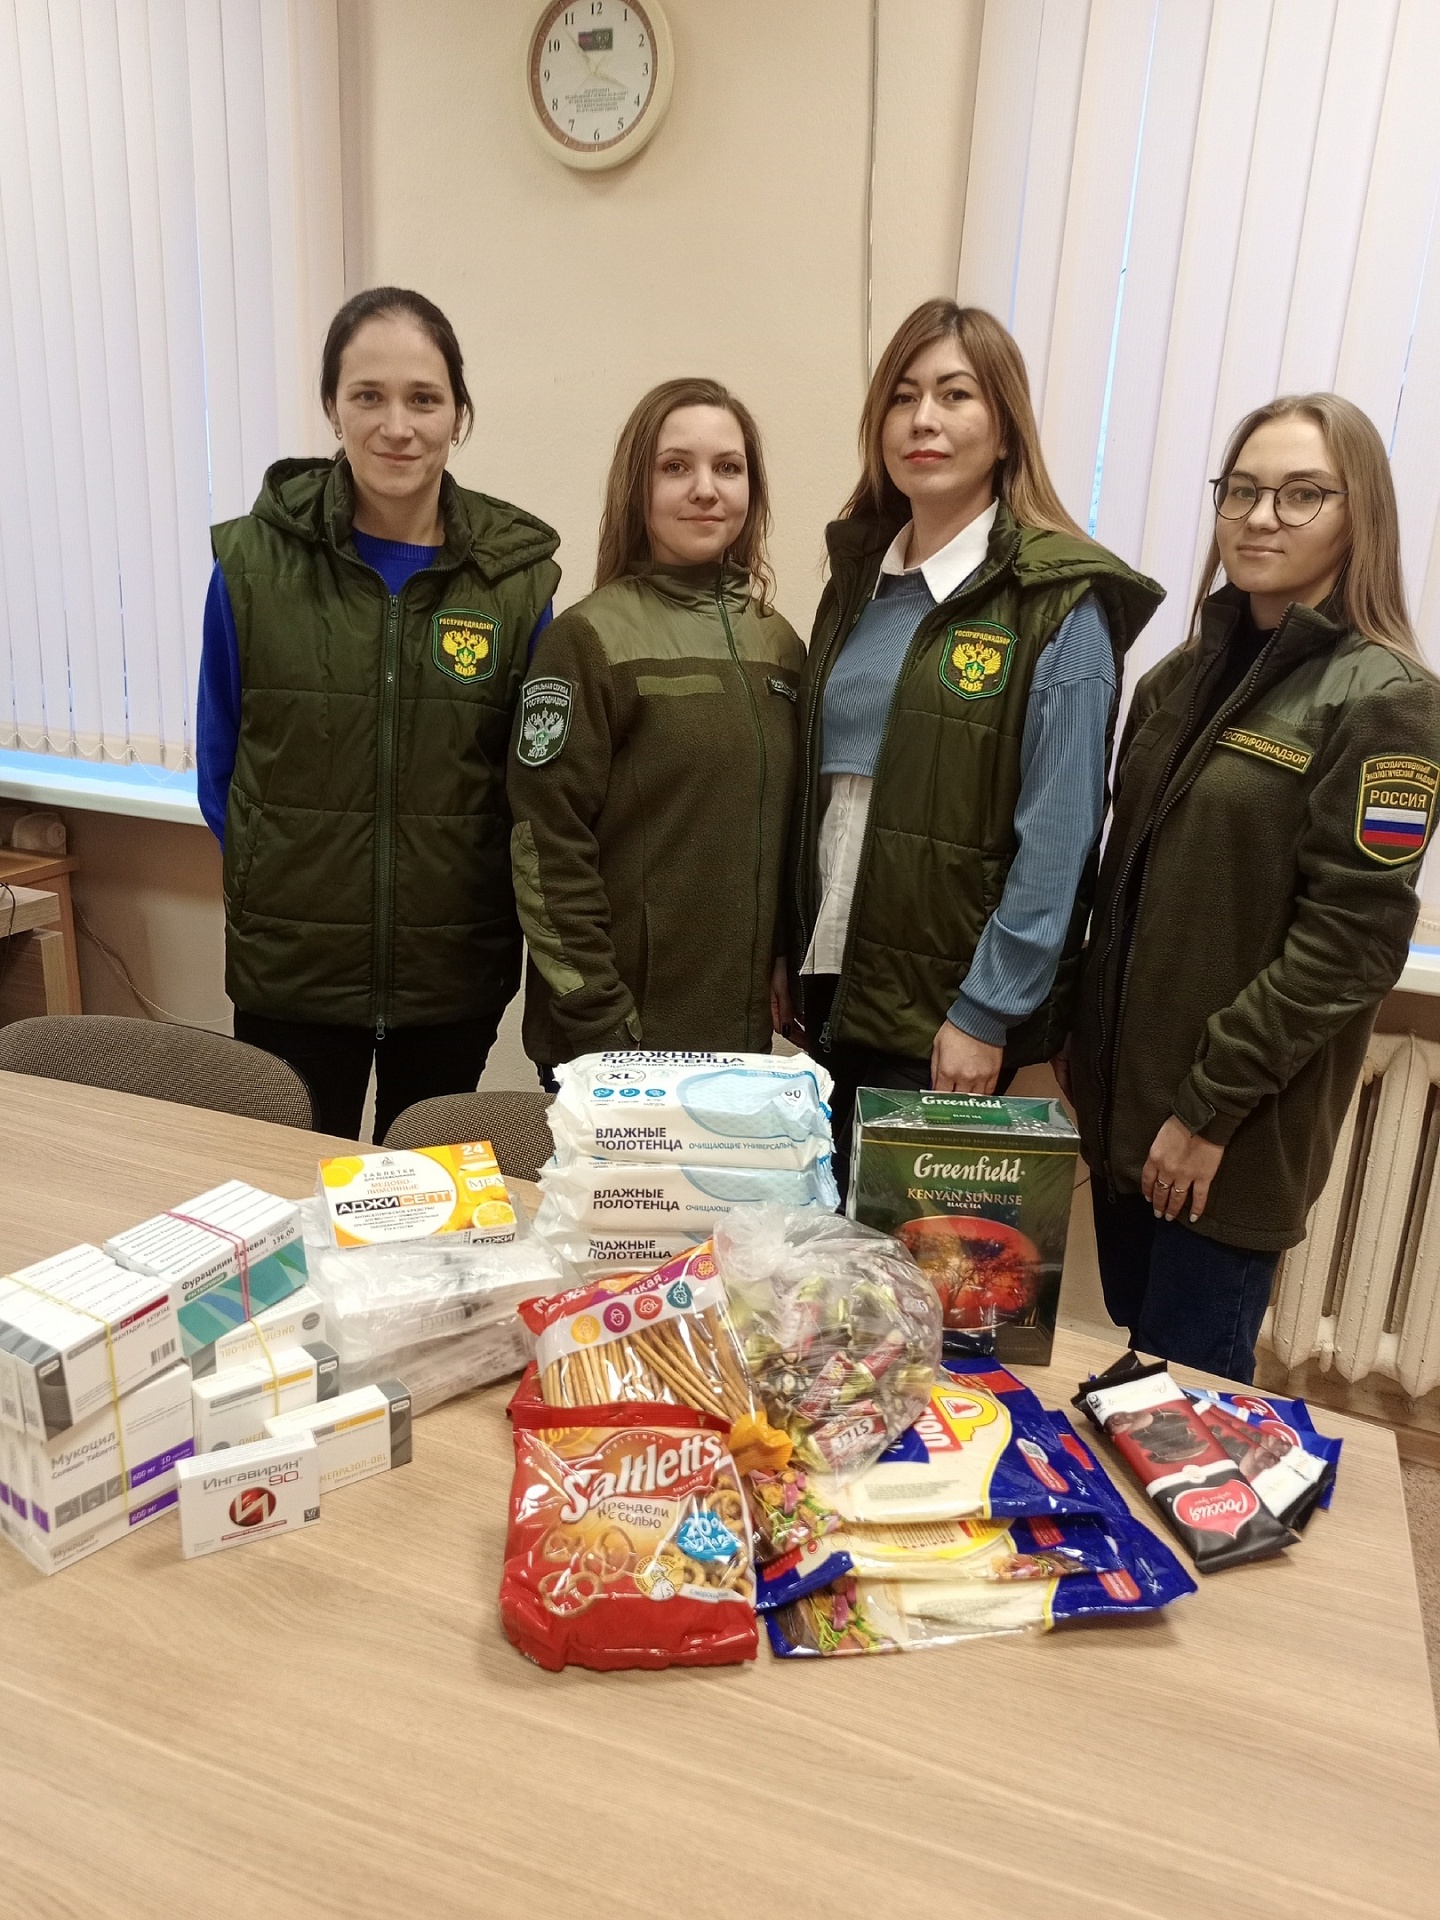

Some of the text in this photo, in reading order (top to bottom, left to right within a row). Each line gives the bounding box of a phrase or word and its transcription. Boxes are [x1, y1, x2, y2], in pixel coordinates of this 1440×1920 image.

[590, 2, 603, 15] 12
[623, 9, 628, 21] 1
[564, 13, 574, 25] 11
[548, 39, 560, 52] 10
[638, 34, 645, 48] 2
[543, 70, 550, 82] 9
[642, 63, 649, 76] 3
[551, 98, 559, 111] 8
[633, 93, 641, 107] 4
[568, 119, 575, 132] 7
[617, 117, 624, 130] 5
[593, 129, 600, 141] 6
[1222, 731, 1307, 766] РОСПРИРОДНАДЗОР
[1369, 789, 1428, 809] РОССИЯ
[601, 1057, 745, 1065] ПОЛОТЕНЦА
[602, 1051, 717, 1060] ВЛАЖНЫЕ
[608, 1072, 636, 1081] XL
[921, 1095, 1003, 1109] Greenfield
[596, 1127, 667, 1139] ВЛАЖНЫЕ
[461, 1144, 484, 1156] 24
[596, 1139, 797, 1152] ПОЛОТЕНЦА ОЧИЩАЮЩИЕ УНИВЕРСАЛЬН
[913, 1152, 1021, 1183] Greenfield
[593, 1188, 664, 1199] ВЛАЖНЫЕ
[907, 1187, 1022, 1206] KENYAN SUNRISE
[337, 1191, 450, 1215] АДЖИСЕПТ
[593, 1199, 680, 1212] ПОЛОТЕНЦА
[947, 1201, 969, 1209] BLACK
[588, 1238, 656, 1251] ВЛАЖНЫЕ
[587, 1247, 673, 1260] ПОЛОТЕНЦА
[181, 1256, 233, 1290] Фурацилин
[51, 1431, 117, 1469] Мукоцил
[605, 1433, 664, 1455] ORIGINAL
[160, 1455, 172, 1466] 10
[318, 1453, 389, 1482] МЕПРАЗОЛ-OBL
[132, 1470, 148, 1482] 600
[203, 1460, 299, 1491] Ингавирин
[268, 1471, 299, 1486] 90
[559, 1433, 722, 1523] Saltletts
[1187, 1491, 1249, 1522] Россия
[131, 1508, 147, 1521] 600
[618, 1513, 662, 1529] солью
